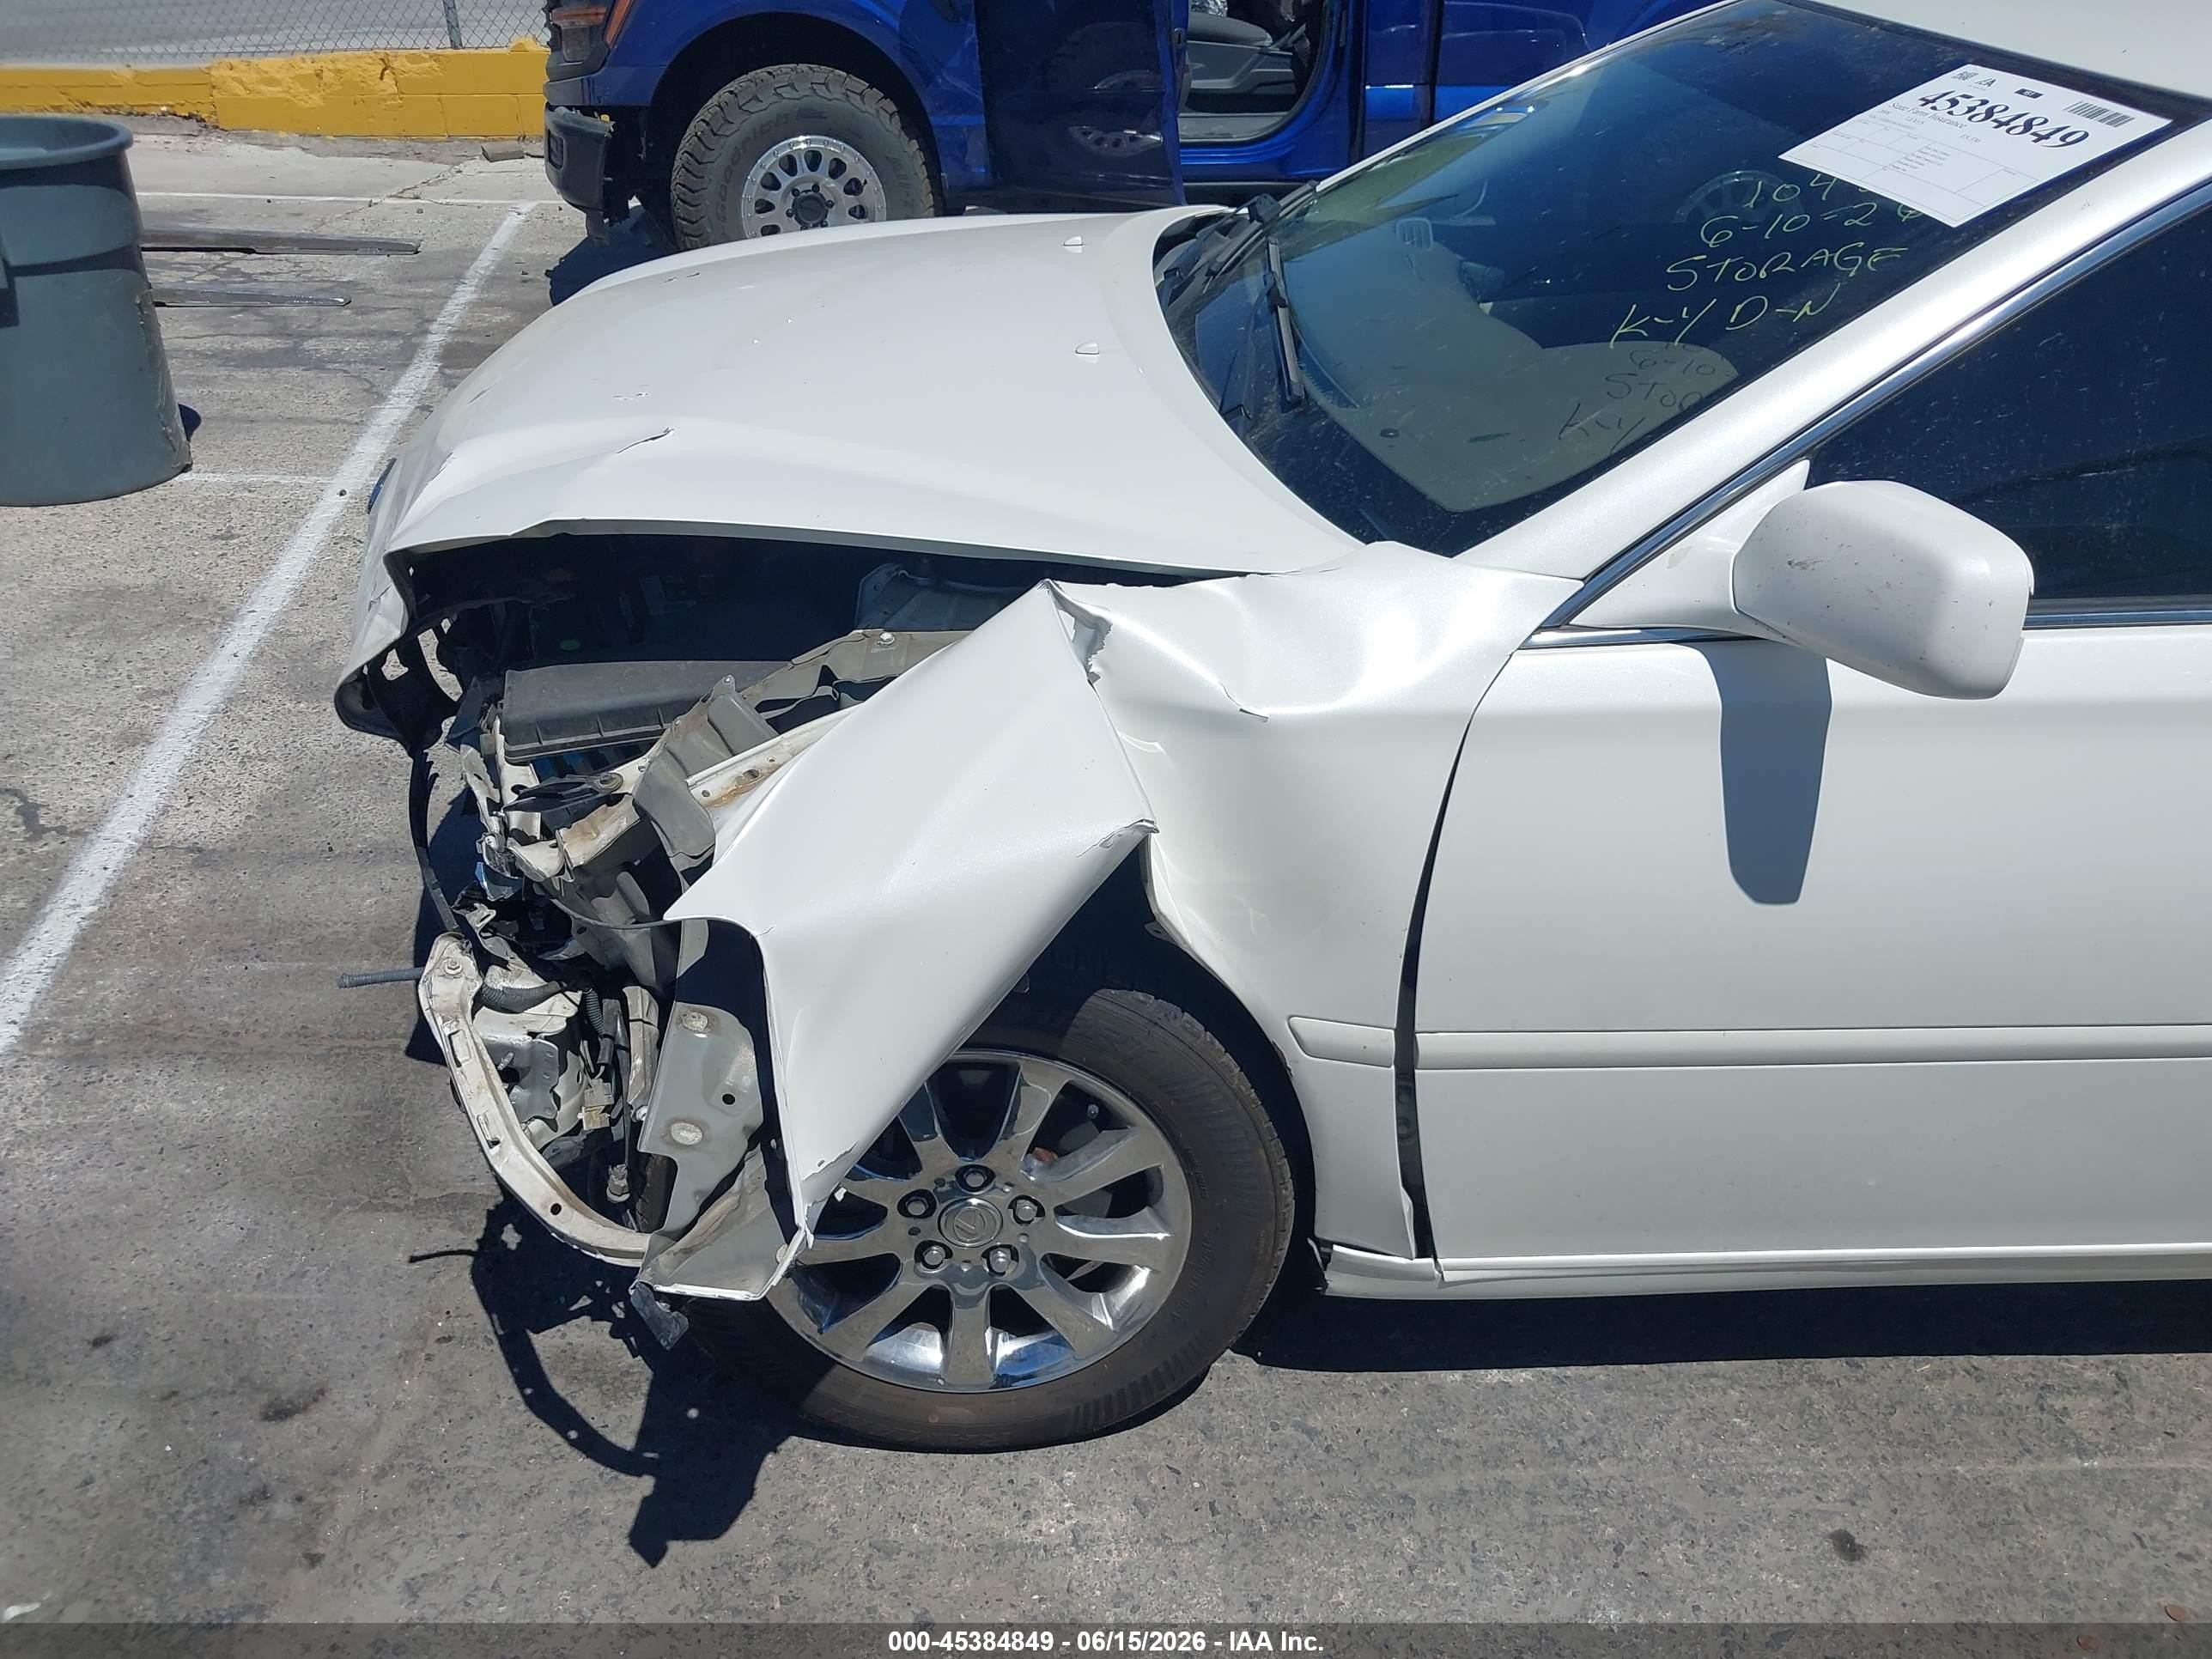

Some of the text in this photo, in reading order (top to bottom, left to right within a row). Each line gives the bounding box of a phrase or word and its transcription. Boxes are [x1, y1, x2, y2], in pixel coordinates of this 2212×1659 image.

[1889, 101, 1911, 113] State
[1908, 106, 1930, 119] Farm
[1927, 111, 1967, 130] Insurance
[1918, 90, 2090, 148] 45384849
[1666, 242, 1908, 291] STORAGE
